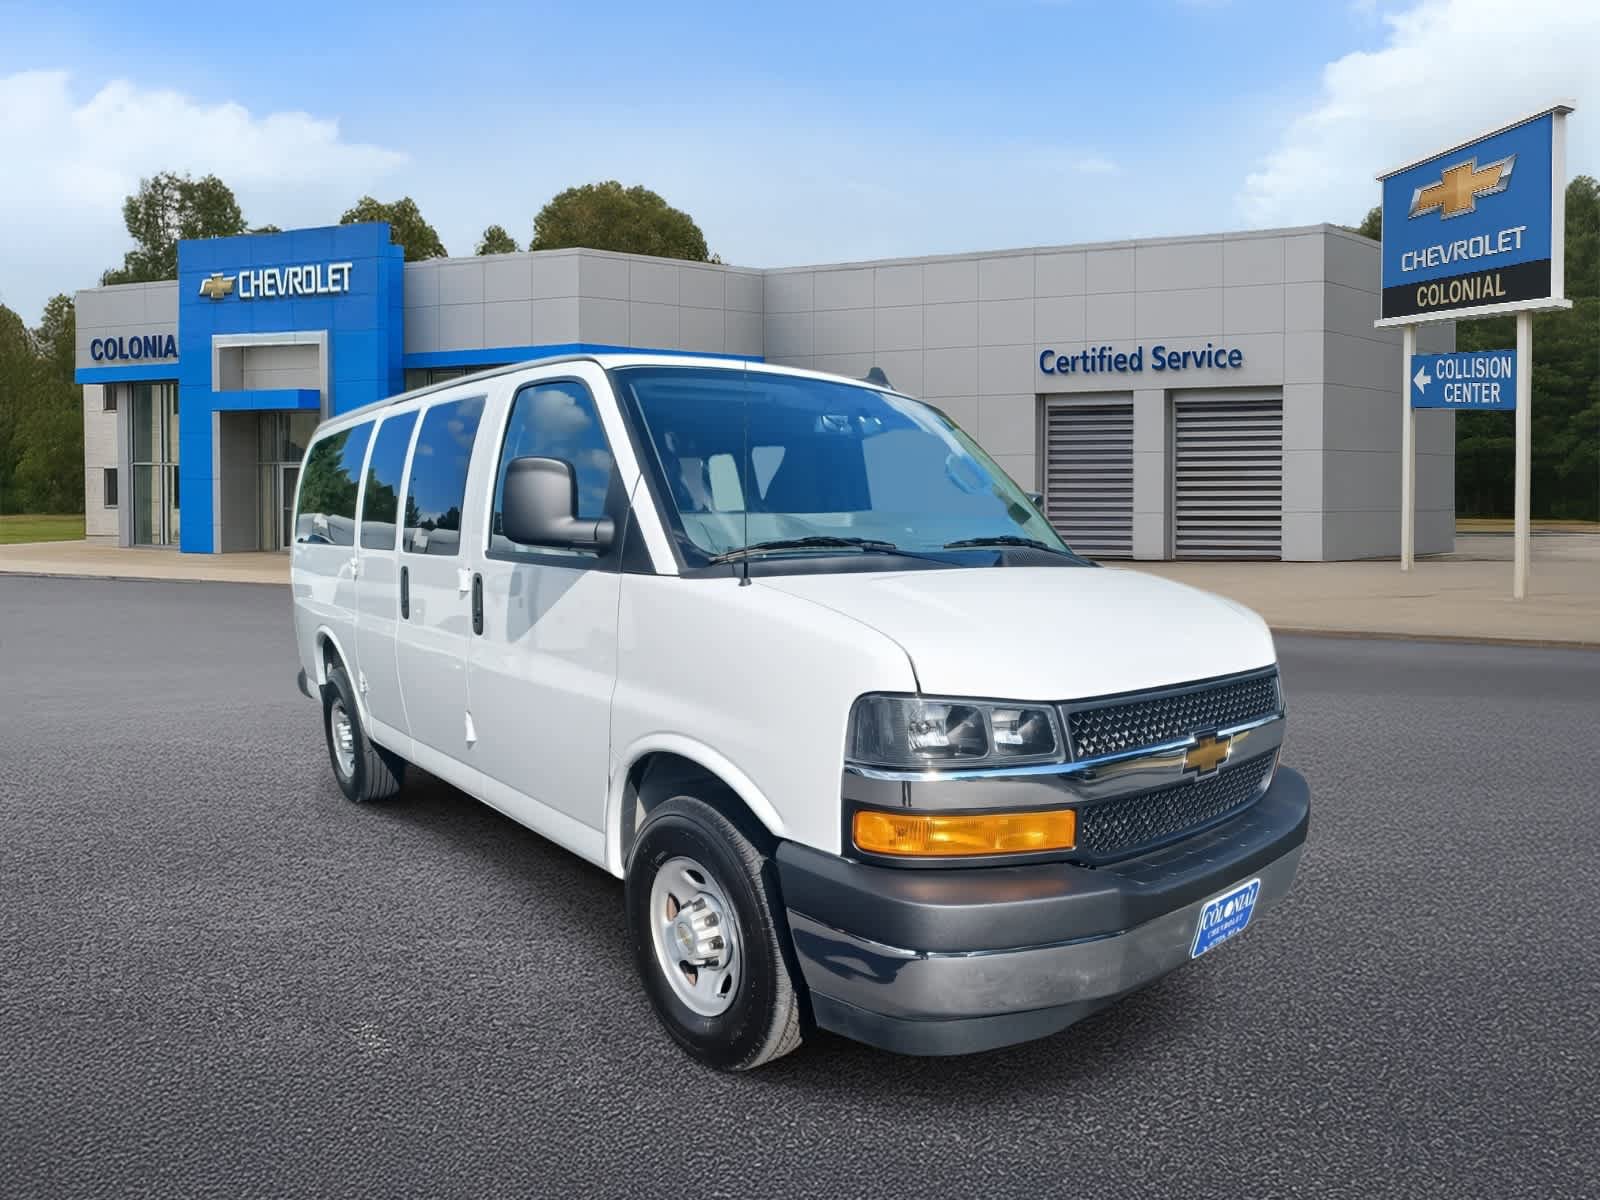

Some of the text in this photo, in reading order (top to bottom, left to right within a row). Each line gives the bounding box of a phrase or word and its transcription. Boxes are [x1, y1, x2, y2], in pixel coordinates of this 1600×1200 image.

[1401, 226, 1527, 271] CHEVROLET
[239, 262, 352, 298] CHEVROLET
[1416, 273, 1506, 307] COLONIAL
[90, 334, 178, 361] COLONIA
[1039, 343, 1243, 374] Certified Service
[1436, 357, 1511, 379] COLLISION
[1444, 383, 1501, 403] CENTER
[1203, 886, 1255, 930] COLONIAL
